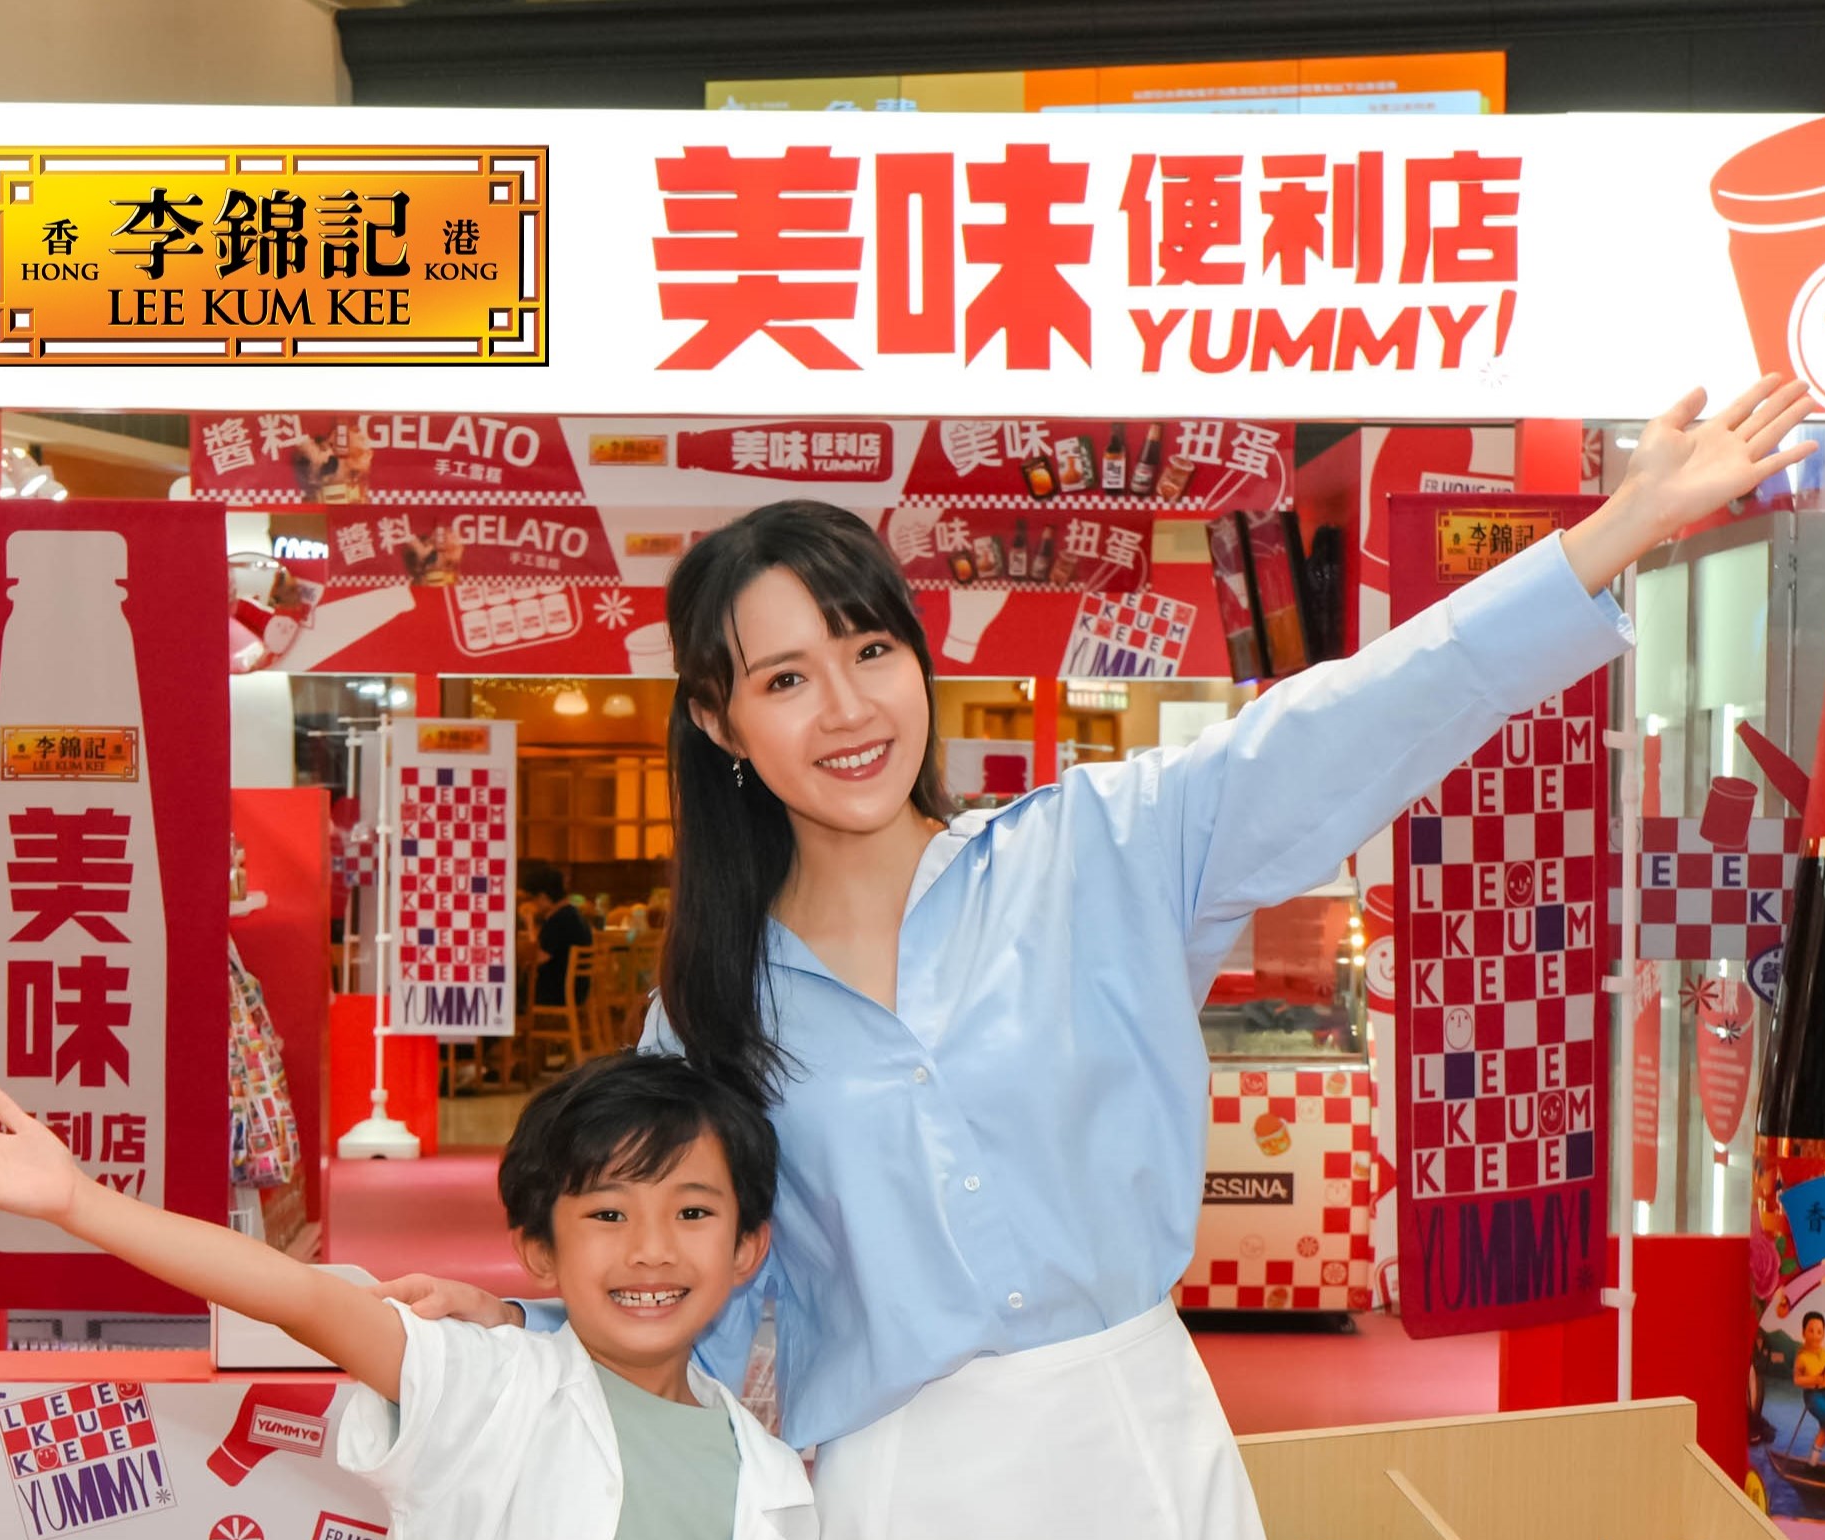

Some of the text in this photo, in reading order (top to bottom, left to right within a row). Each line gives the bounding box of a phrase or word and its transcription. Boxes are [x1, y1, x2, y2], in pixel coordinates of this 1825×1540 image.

[41, 187, 481, 280] 香 李錦記 港
[21, 263, 499, 282] HONG KONG
[107, 288, 412, 327] LEE KUM KEE
[359, 415, 541, 468] GELATO
[452, 514, 589, 558] GELATO
[1467, 522, 1534, 556] 李錦記
[35, 736, 106, 760] 李錦記
[33, 761, 106, 772] LEE KUM KEE
